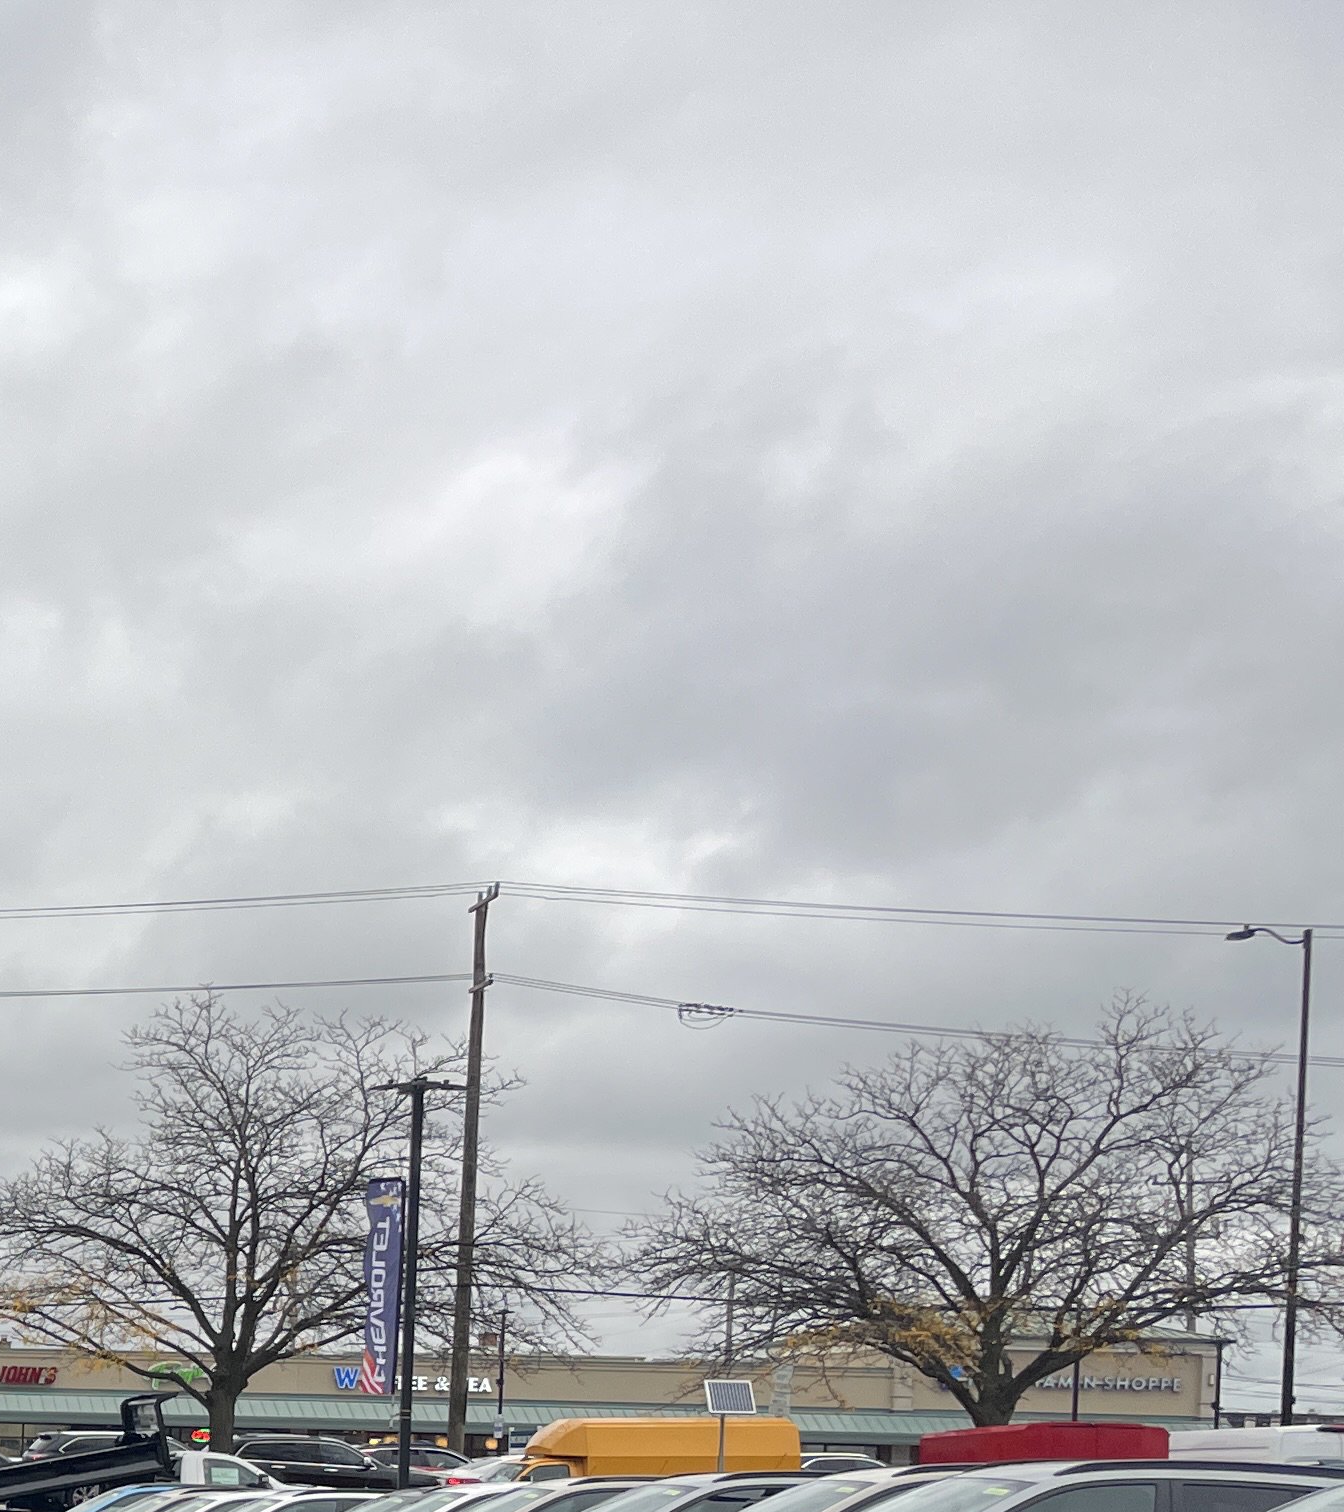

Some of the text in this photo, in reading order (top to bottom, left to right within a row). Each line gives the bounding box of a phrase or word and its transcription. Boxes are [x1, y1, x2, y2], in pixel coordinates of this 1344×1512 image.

[369, 1216, 391, 1383] CHEVROLET
[465, 1377, 492, 1393] EA
[1103, 1376, 1182, 1393] SHOPPE
